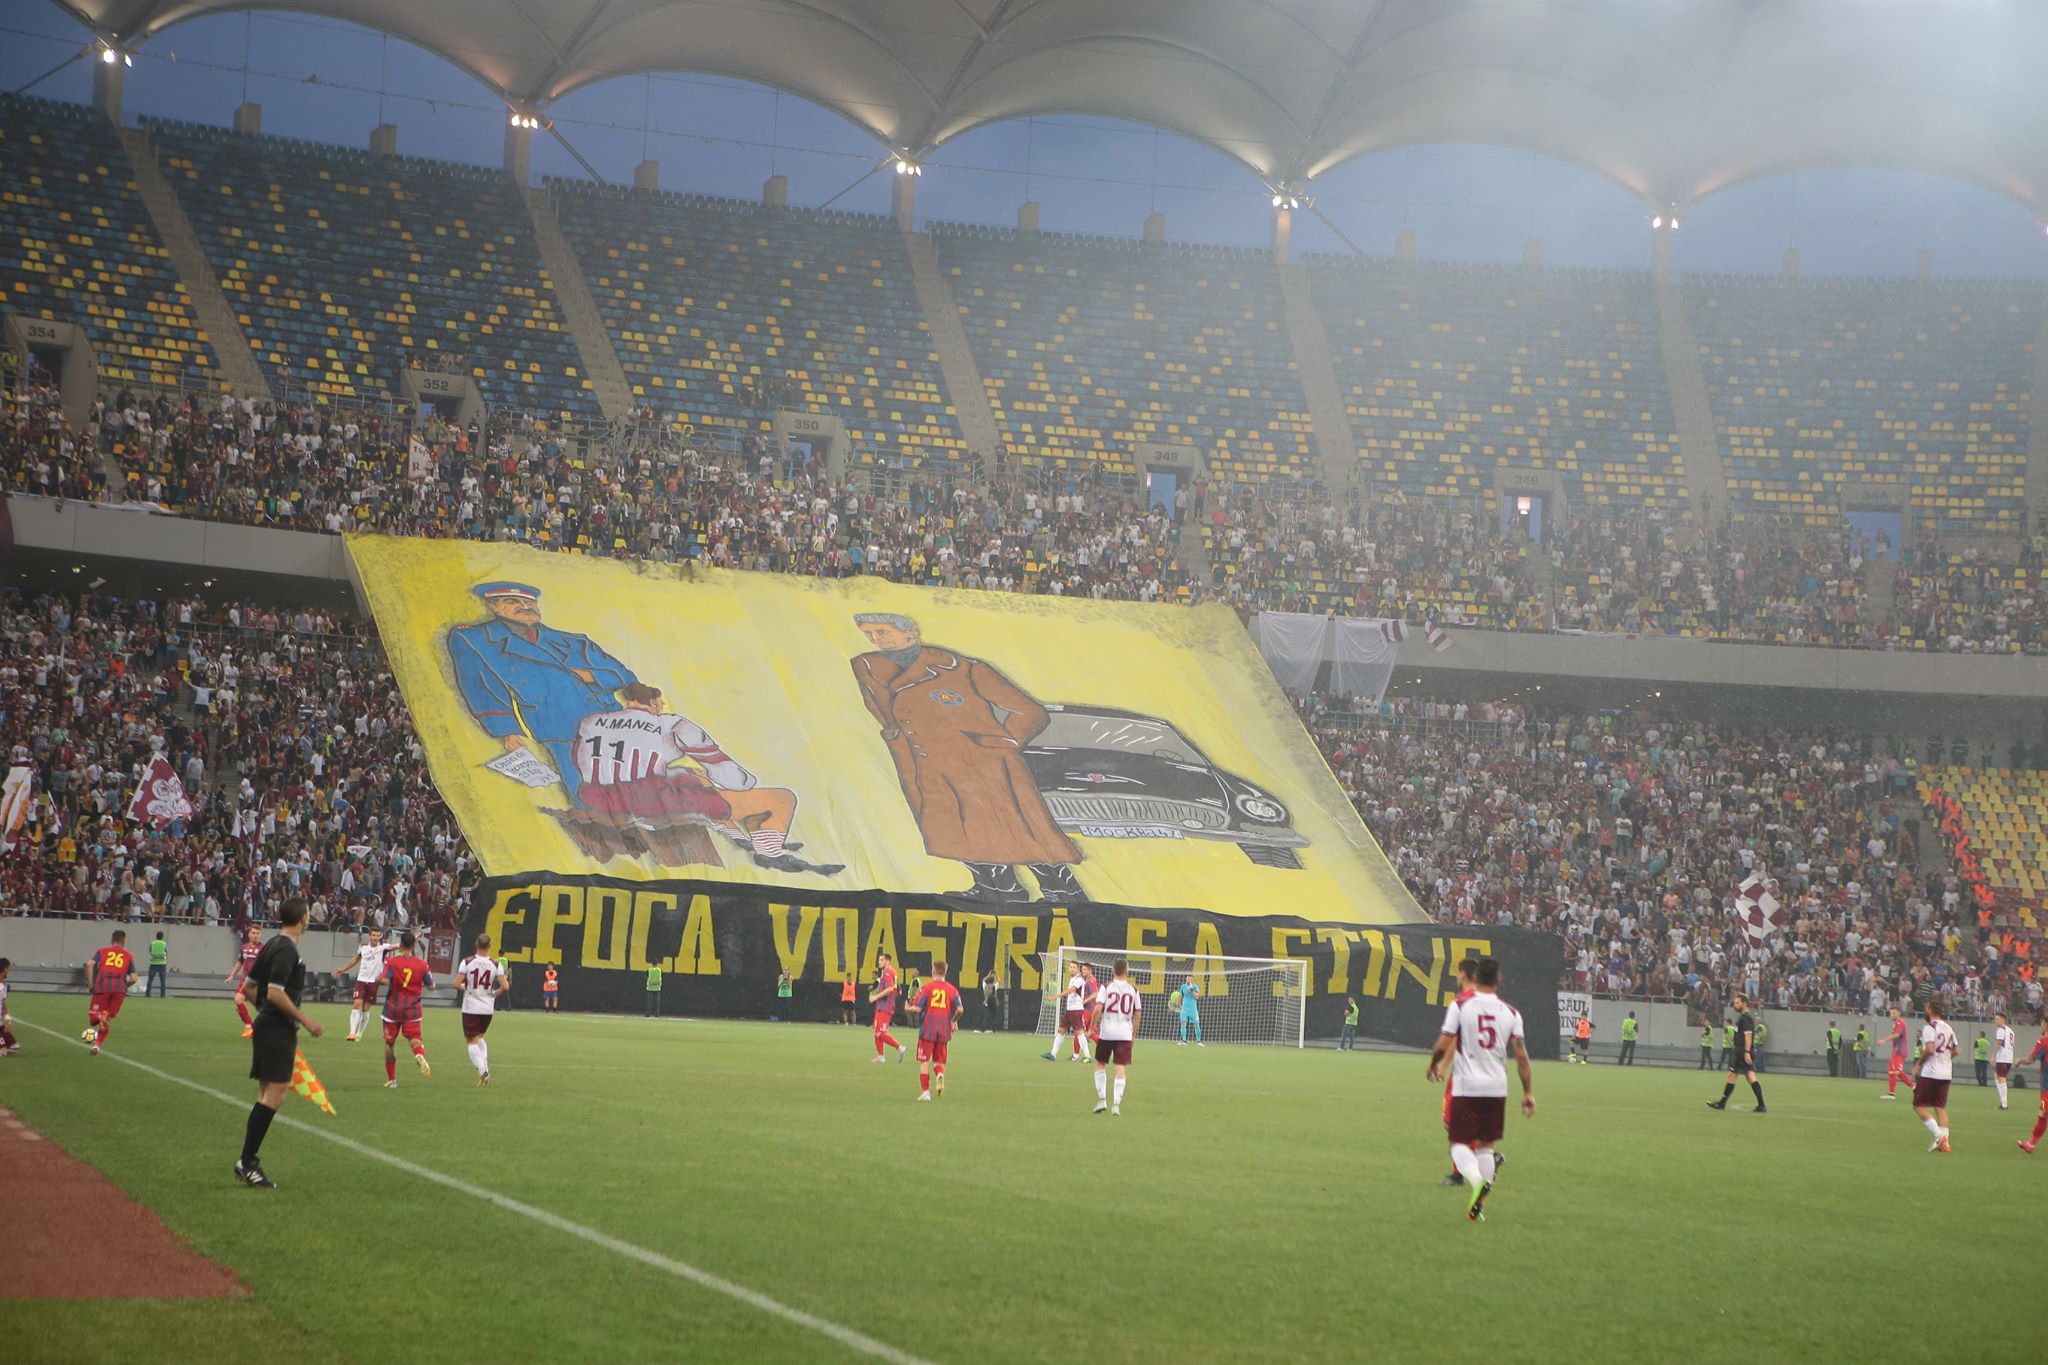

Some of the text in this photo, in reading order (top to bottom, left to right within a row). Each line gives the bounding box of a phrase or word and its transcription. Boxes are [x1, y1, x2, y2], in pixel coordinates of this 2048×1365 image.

[28, 325, 56, 339] 354
[423, 379, 449, 391] 352
[795, 419, 819, 430] 350
[1154, 451, 1178, 461] 348
[595, 717, 662, 735] N.MANEA
[585, 735, 625, 763] 11
[484, 884, 721, 975] EPOCA
[105, 951, 124, 968] 26
[403, 967, 413, 988] 7
[470, 968, 491, 990] 14
[930, 988, 947, 1008] 21
[1107, 992, 1133, 1015] 20
[1478, 1014, 1497, 1050] 5
[1935, 1033, 1957, 1053] 24
